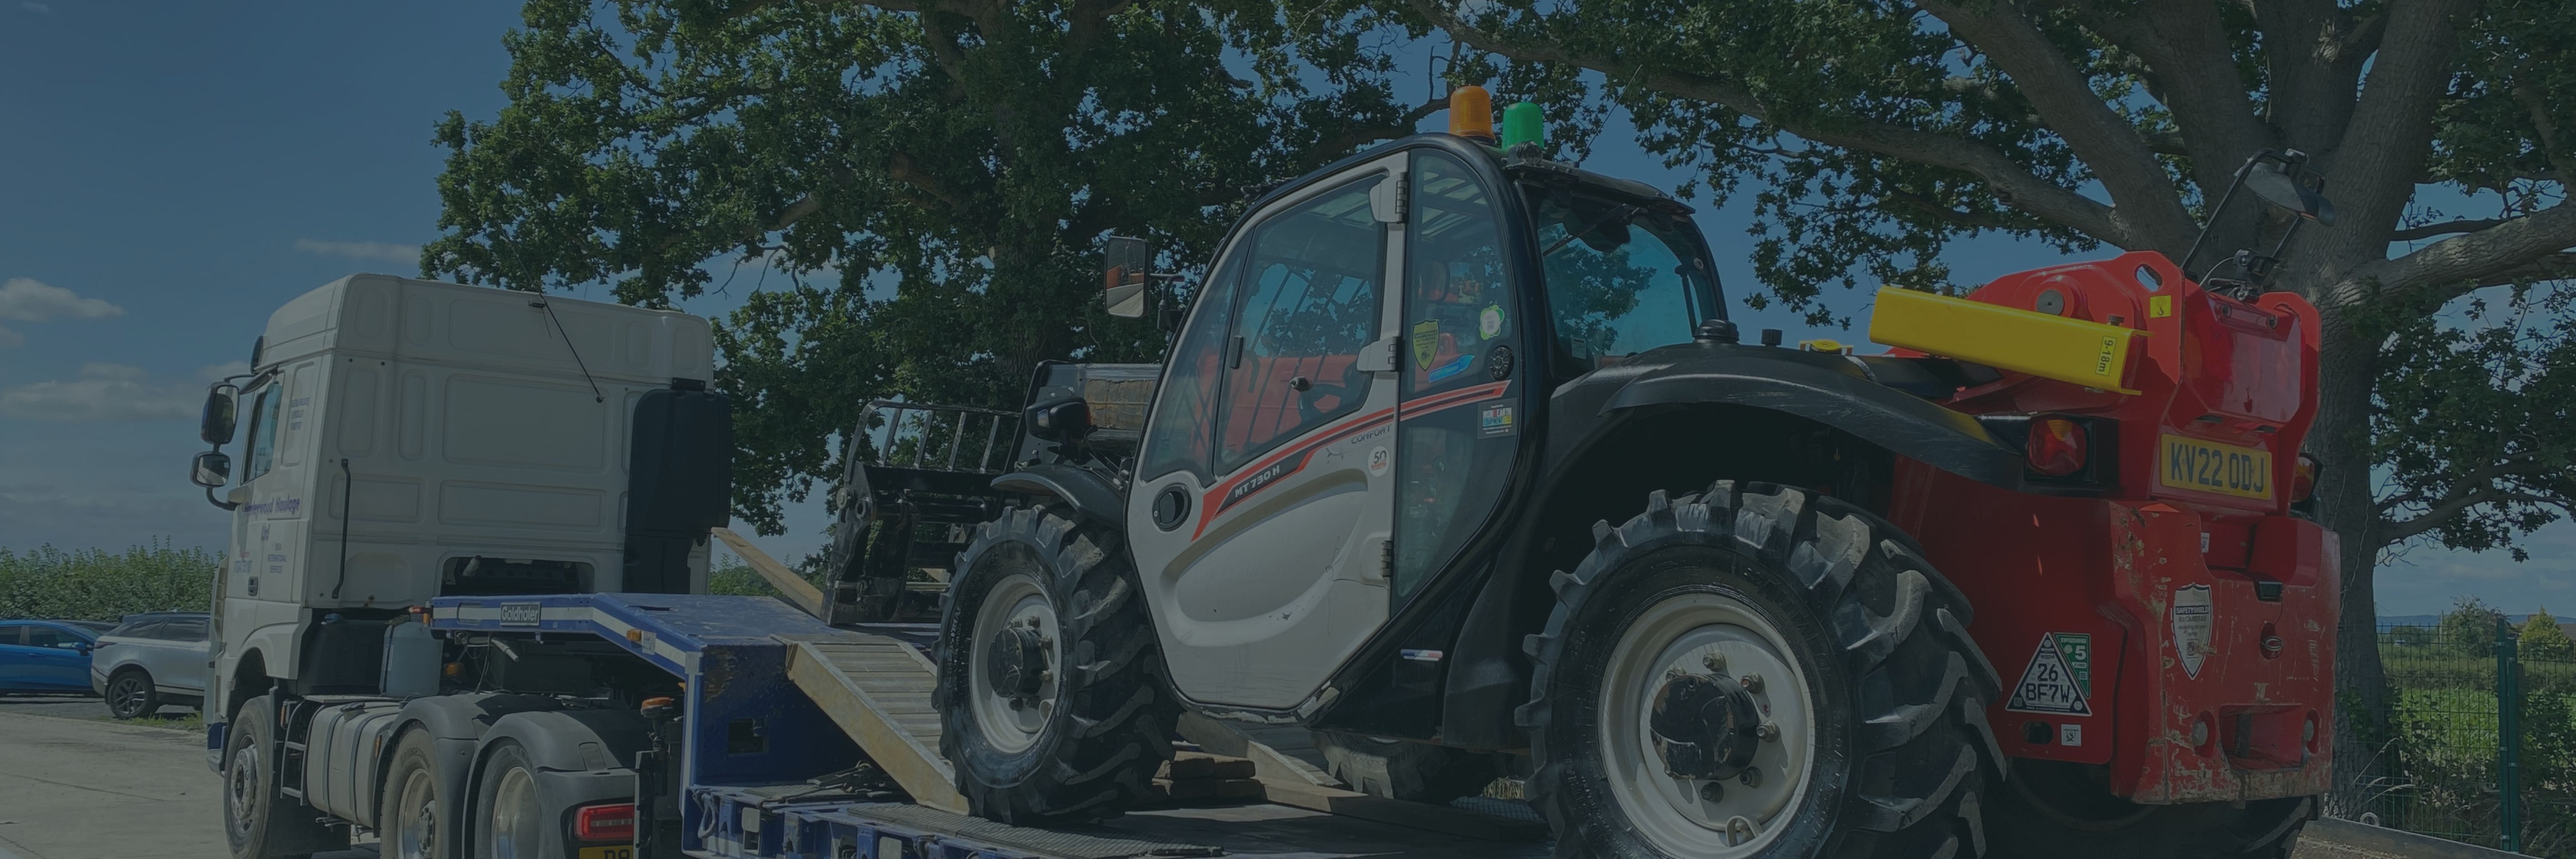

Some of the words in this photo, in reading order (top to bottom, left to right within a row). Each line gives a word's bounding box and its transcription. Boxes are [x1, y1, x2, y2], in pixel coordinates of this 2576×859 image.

[2171, 442, 2223, 487] KV22
[2229, 453, 2264, 493] ODJ
[1235, 482, 1249, 498] MT
[1250, 470, 1271, 489] 730
[1272, 464, 1280, 476] H
[275, 494, 300, 516] Haulage
[2074, 645, 2087, 660] 5
[2037, 663, 2058, 682] 26
[2025, 683, 2071, 703] BF7W
